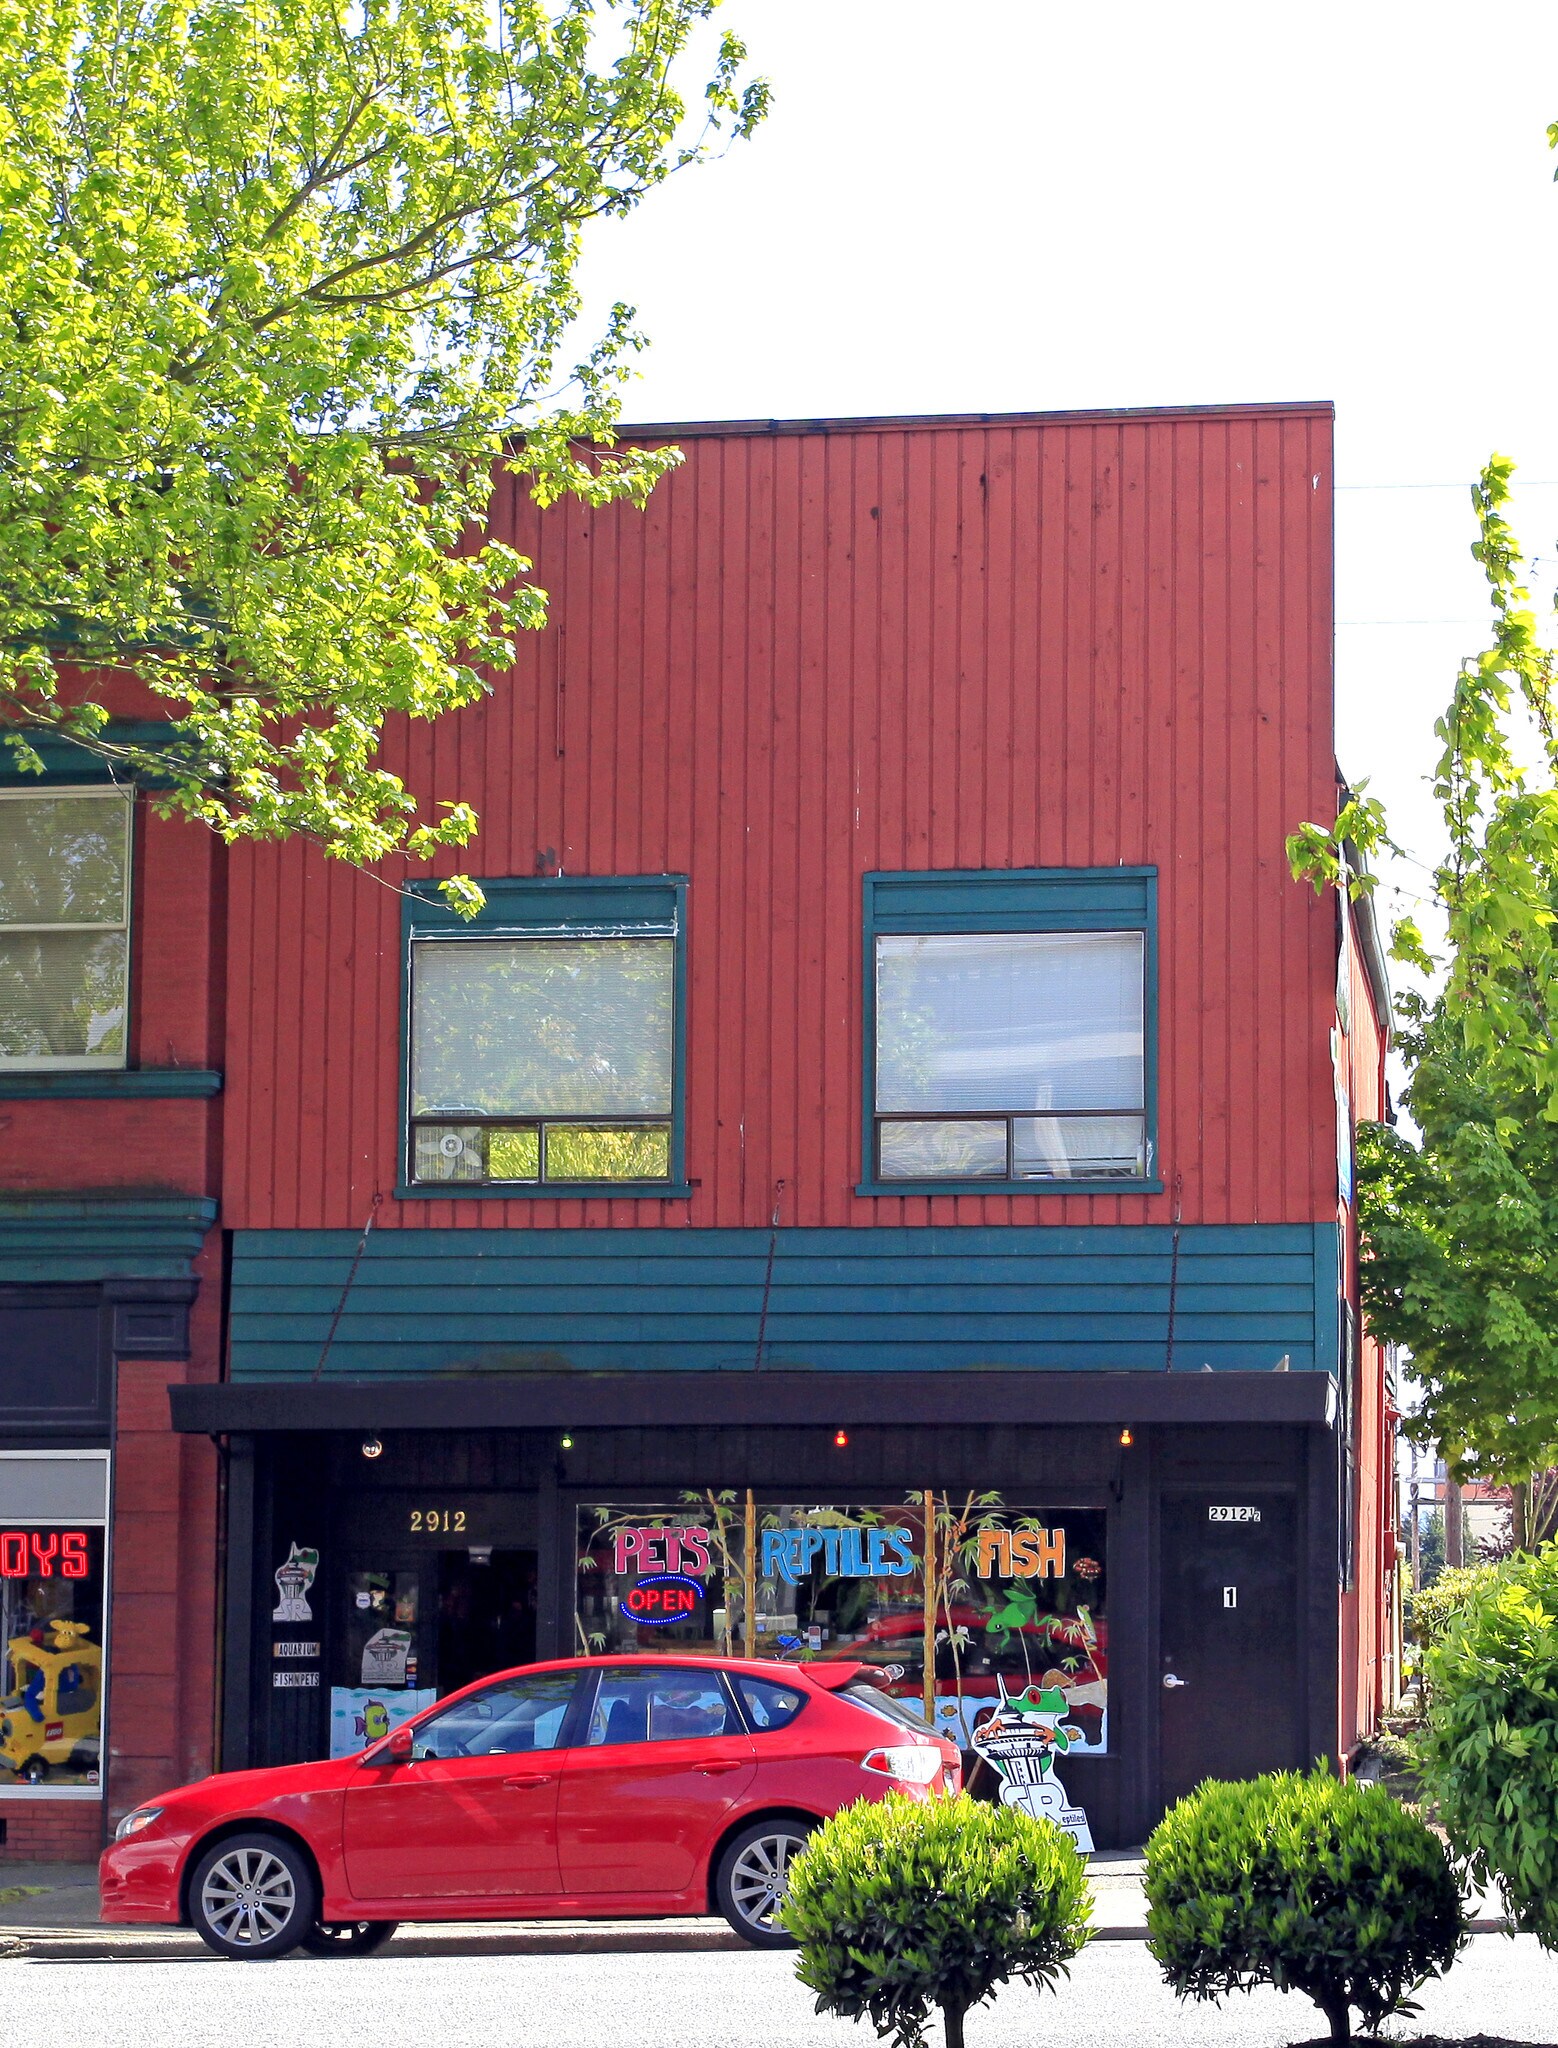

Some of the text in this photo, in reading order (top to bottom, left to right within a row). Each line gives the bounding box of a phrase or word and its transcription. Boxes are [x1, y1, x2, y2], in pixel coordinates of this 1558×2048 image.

[411, 1511, 467, 1532] 2912
[1, 1532, 88, 1578] OYS
[614, 1526, 1066, 1586] PETS REPTILES FISH
[628, 1589, 695, 1611] OPEN
[1225, 1588, 1234, 1607] 1
[279, 1643, 317, 1656] AQUARIUM
